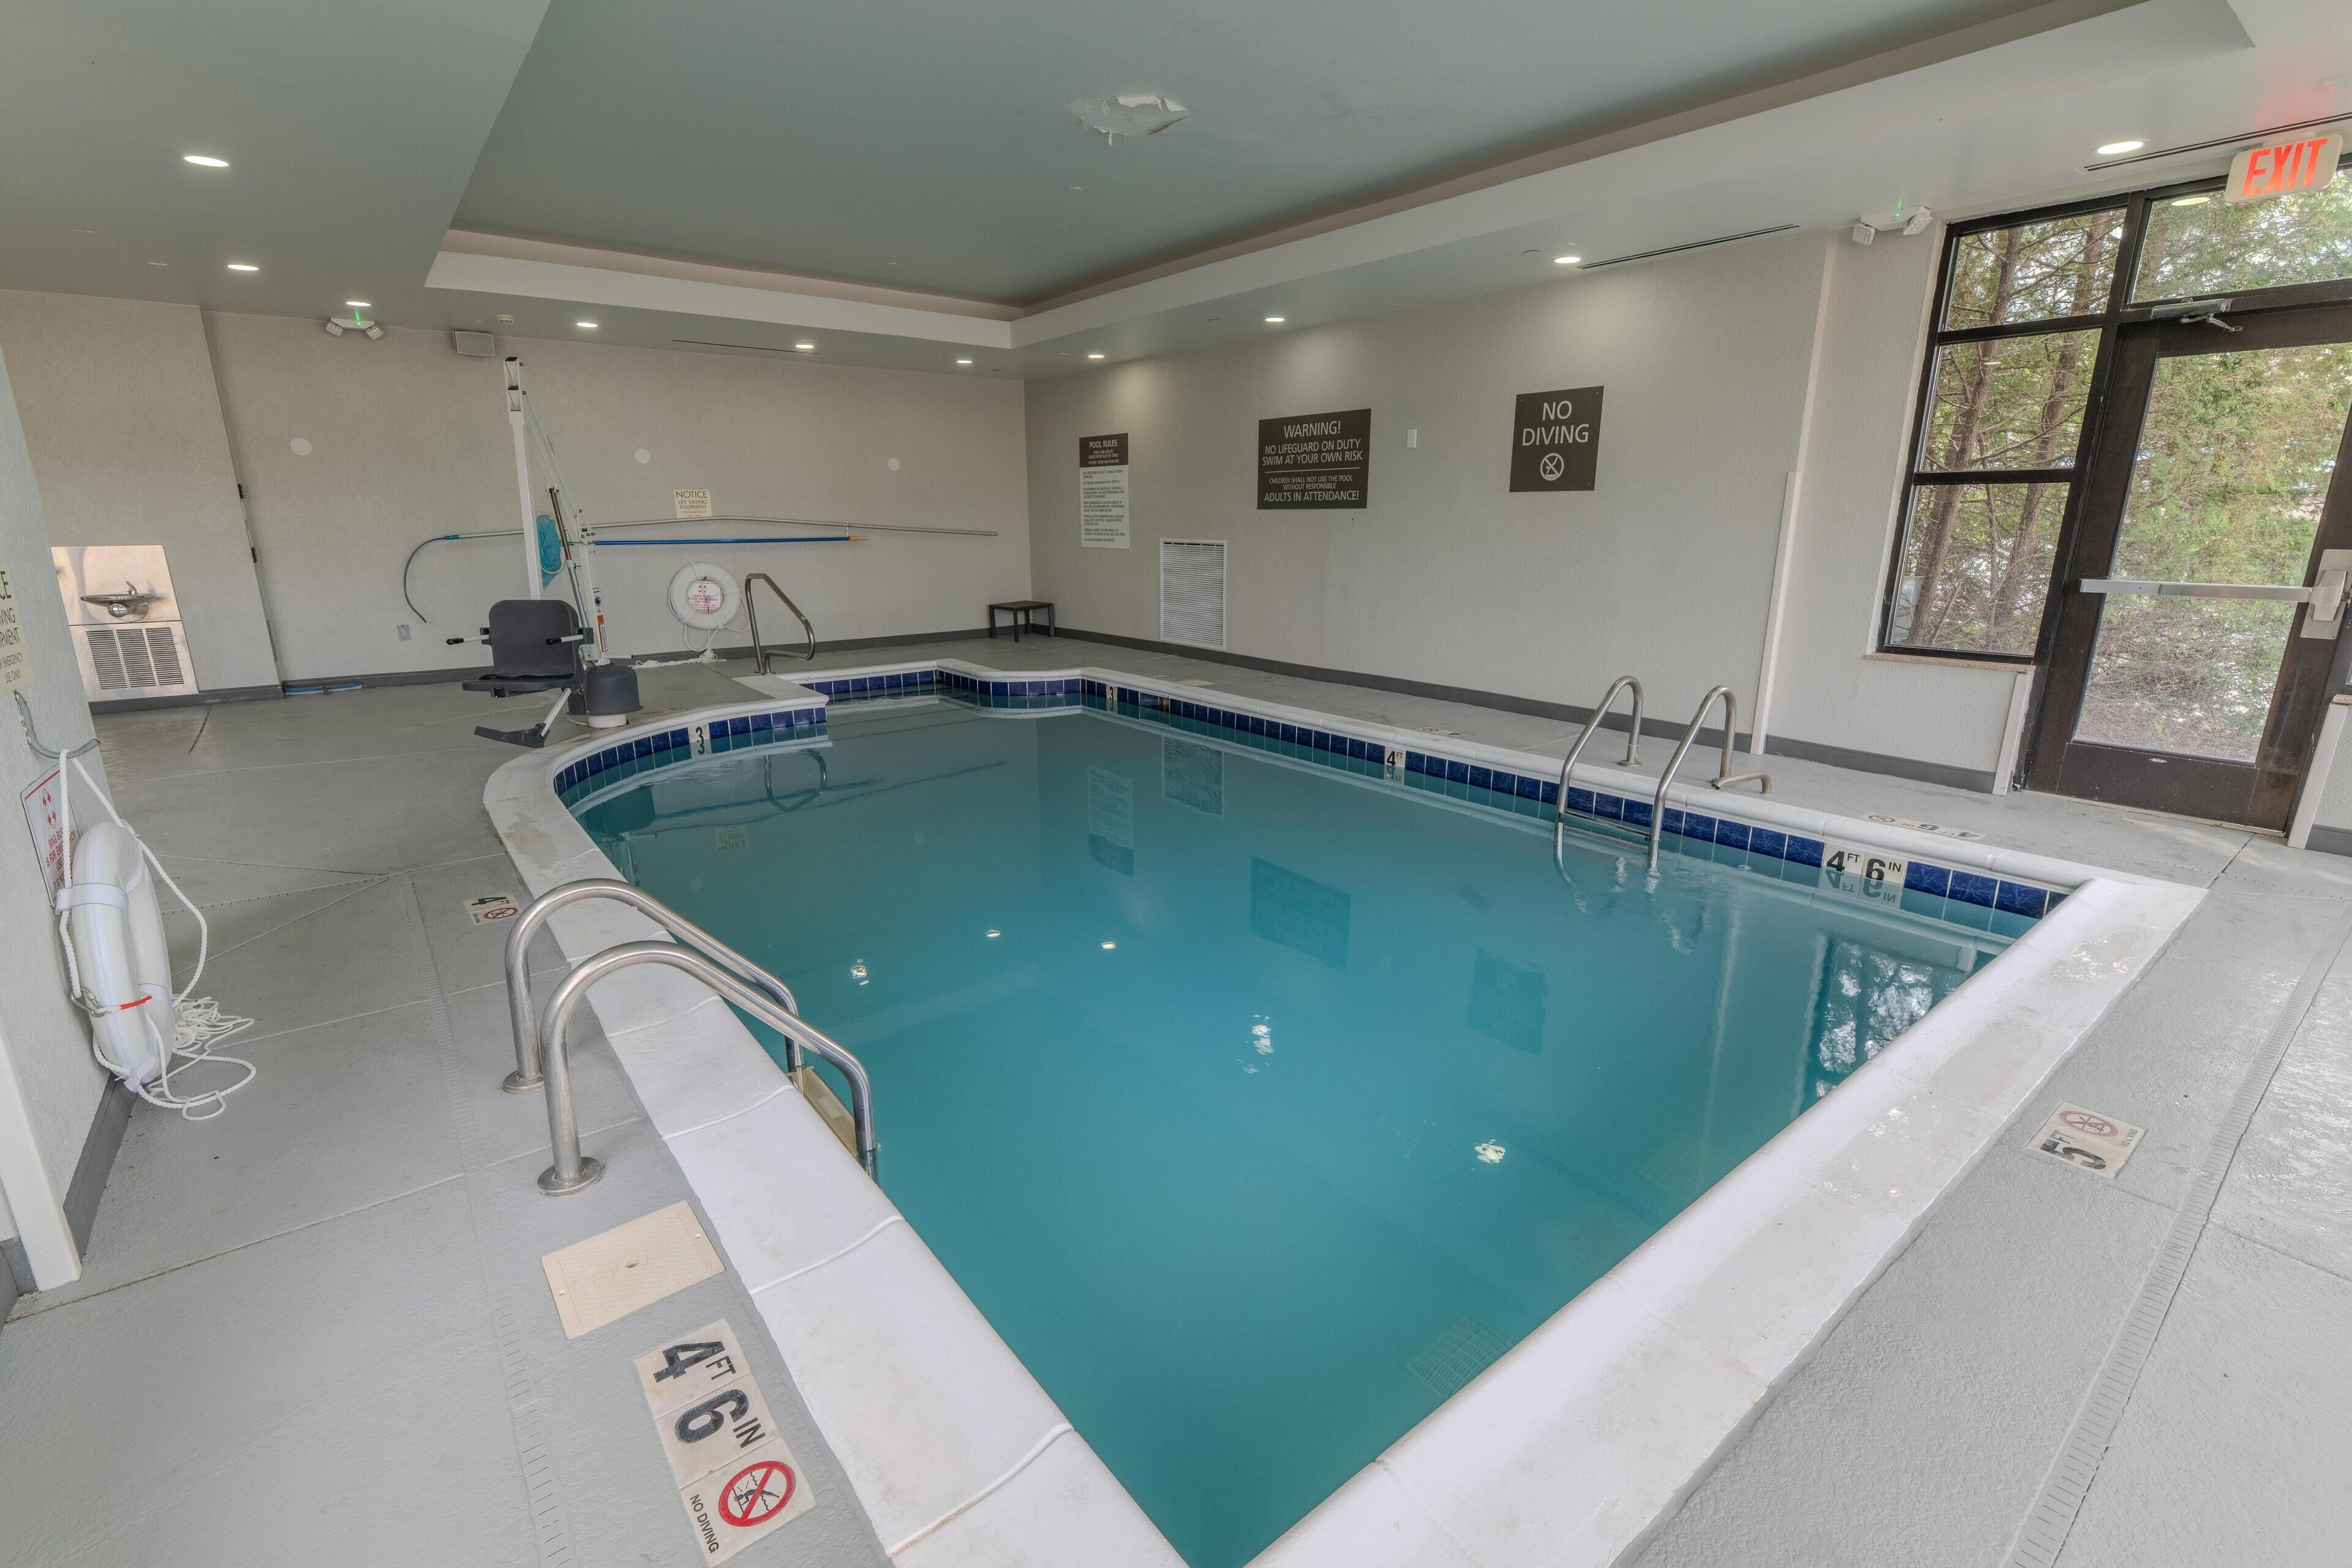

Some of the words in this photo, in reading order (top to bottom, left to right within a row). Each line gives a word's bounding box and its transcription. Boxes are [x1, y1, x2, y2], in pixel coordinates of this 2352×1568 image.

[2242, 137, 2328, 196] EXIT
[1542, 401, 1572, 421] NO
[1284, 421, 1341, 438] WARNING!
[1523, 424, 1589, 446] DIVING
[1265, 445, 1276, 454] NO
[1279, 442, 1319, 453] LIFEGUARD
[1322, 441, 1334, 451] ON
[1337, 439, 1361, 450] DUTY
[1263, 456, 1283, 466] SWIM
[1285, 455, 1295, 464] AT
[1297, 454, 1318, 463] YOUR
[1321, 452, 1341, 462] OWN
[1345, 450, 1363, 461] RISK
[1264, 492, 1291, 502] ADULTS
[1294, 492, 1301, 501] IN
[1303, 491, 1359, 501] ATTENDANCE!
[2, 652, 23, 668] EMERGENCY
[12, 669, 21, 680] ONLY
[1110, 686, 1114, 701] 3
[696, 726, 704, 742] 3
[1387, 751, 1396, 766] 4
[48, 834, 57, 849] RING
[46, 857, 50, 868] IS
[1826, 851, 1845, 872] 4
[1847, 853, 1860, 863] FT
[1866, 858, 1885, 881] 6
[1888, 861, 1901, 873] IN
[472, 897, 507, 905] 4
[2049, 1129, 2075, 1144] FT
[2040, 1138, 2107, 1170] 5
[653, 1341, 726, 1383] 4
[706, 1355, 736, 1381] FT
[674, 1389, 750, 1444] 6
[733, 1417, 766, 1449] IN
[690, 1494, 703, 1513] NO
[697, 1513, 719, 1554] DIVING
